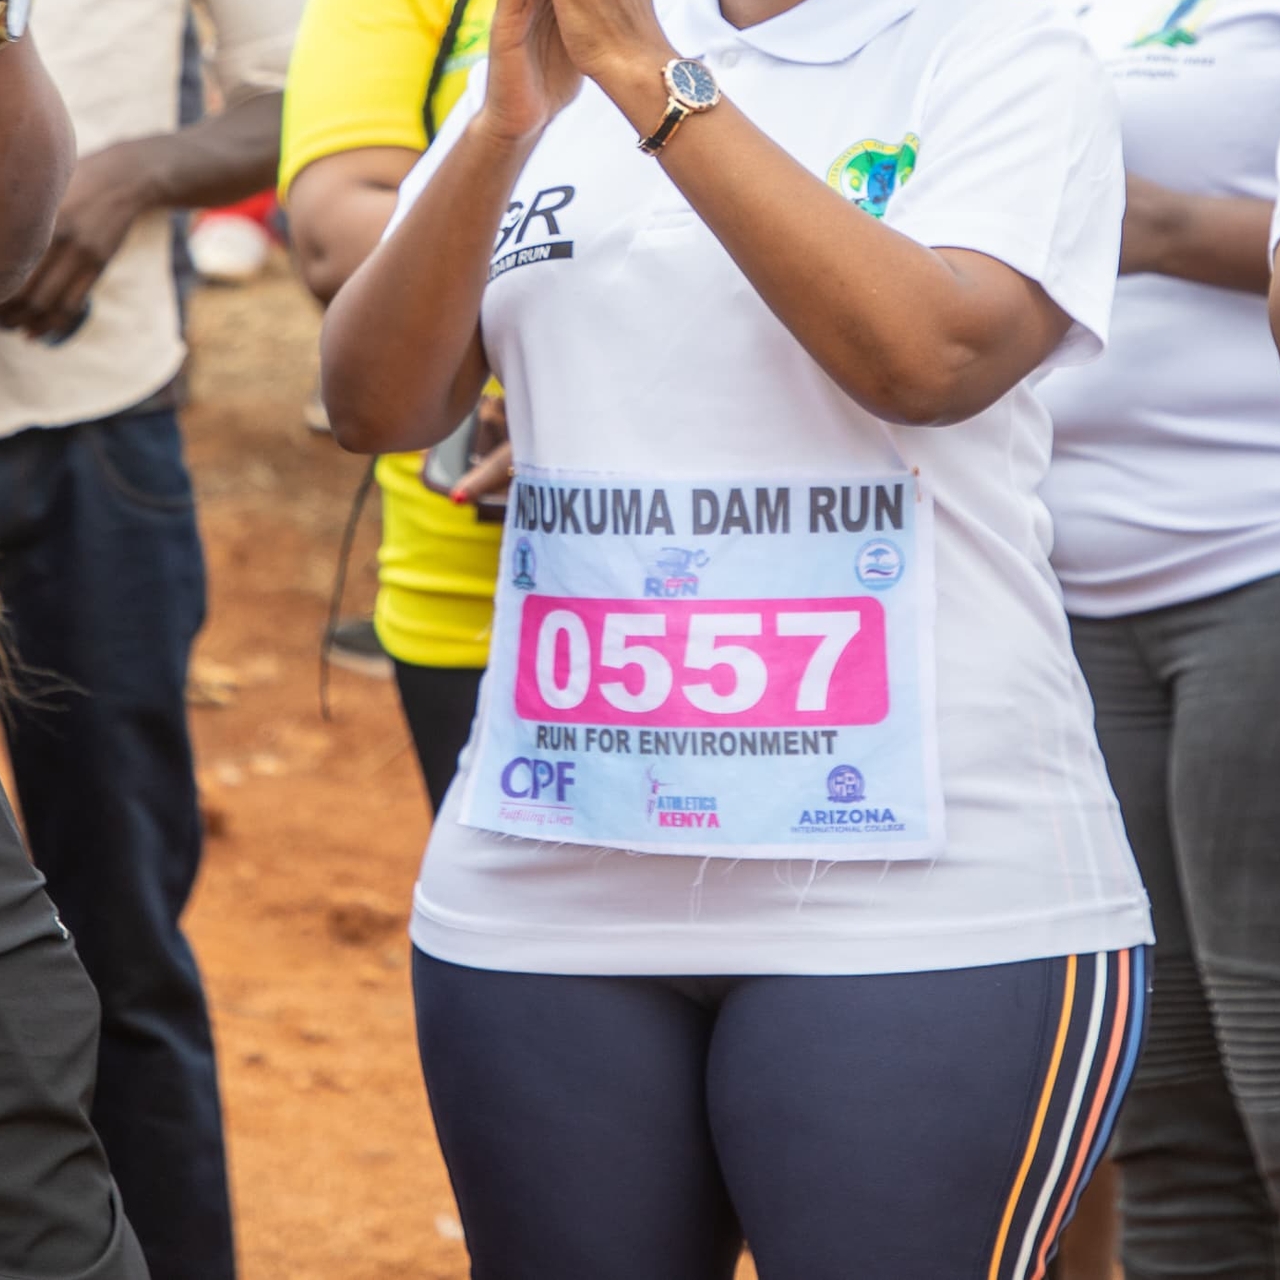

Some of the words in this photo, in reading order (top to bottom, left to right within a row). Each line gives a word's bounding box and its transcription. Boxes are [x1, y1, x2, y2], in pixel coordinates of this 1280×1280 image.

[518, 245, 551, 266] RUN
[692, 487, 790, 535] DAM
[809, 484, 904, 534] RUN
[536, 609, 860, 714] 0557
[536, 725, 577, 752] RUN
[585, 729, 631, 753] FOR
[639, 730, 838, 757] ENVIRONMENT
[500, 757, 576, 802] CPF
[659, 811, 721, 828] KENYA
[799, 808, 897, 825] ARIZONA
